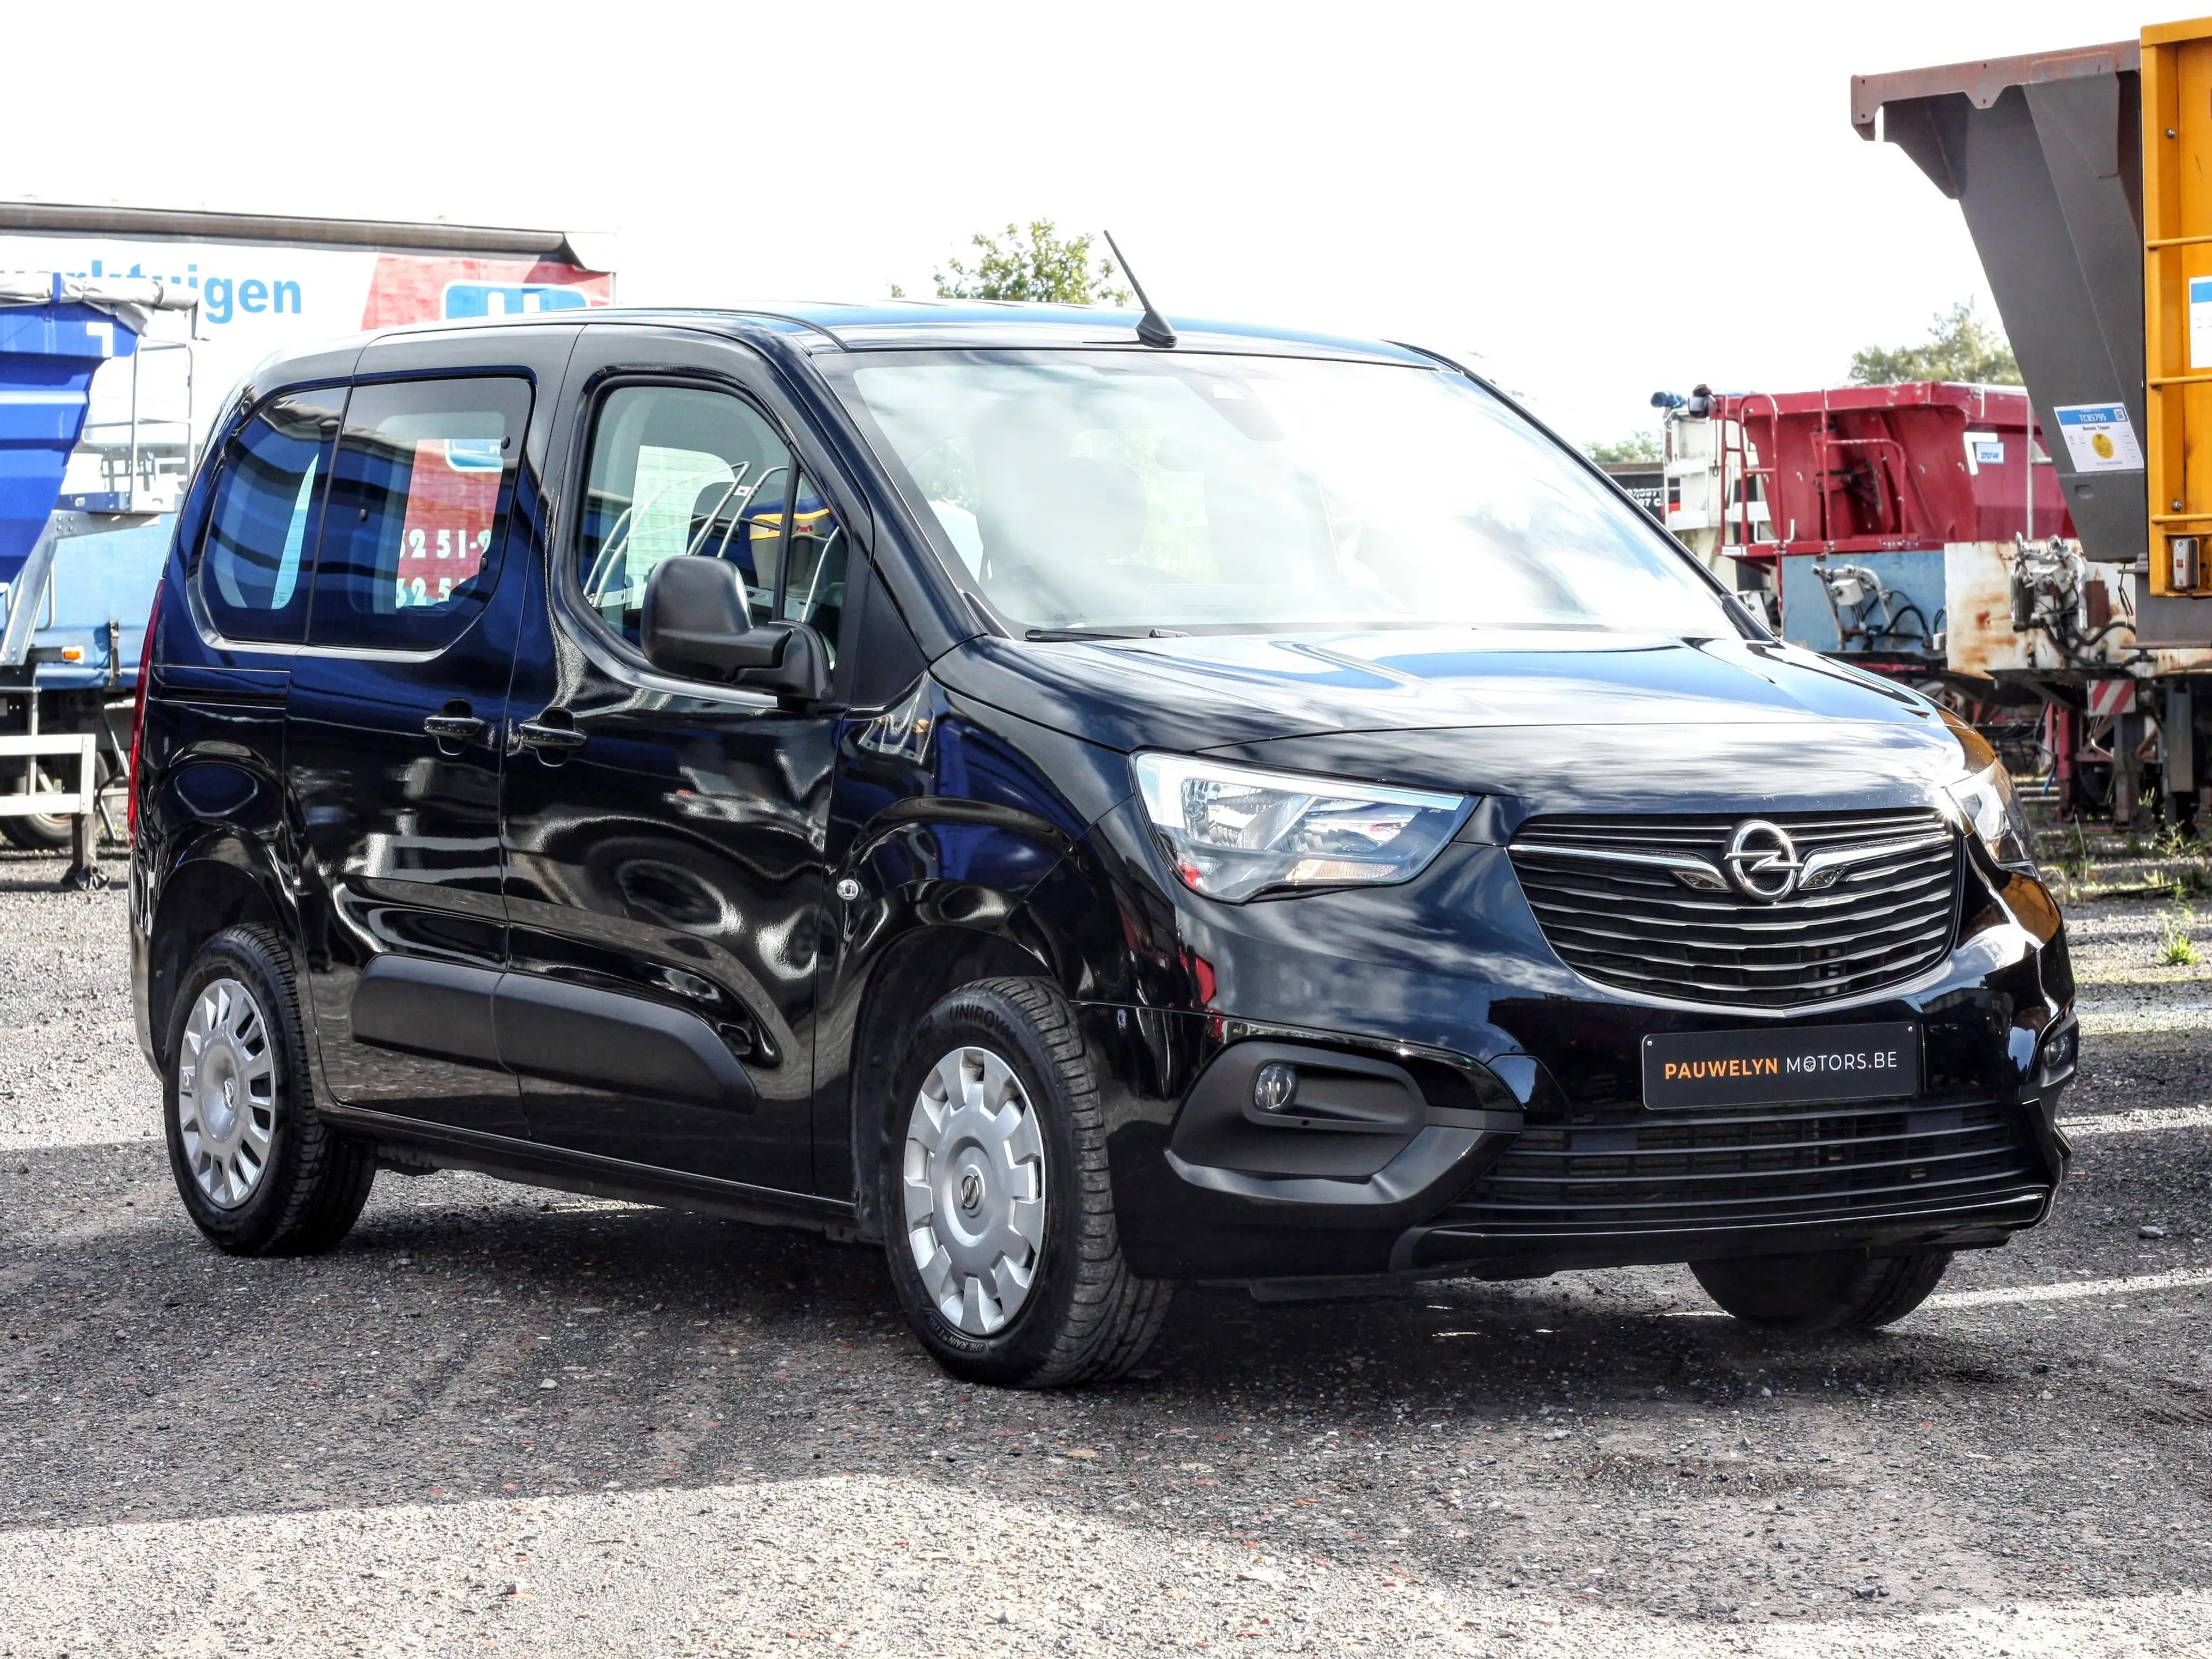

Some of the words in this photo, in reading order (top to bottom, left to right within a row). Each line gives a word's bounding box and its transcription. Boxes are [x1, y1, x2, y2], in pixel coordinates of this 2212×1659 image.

[1665, 1058, 1779, 1080] PAUWELYN
[1786, 1051, 1898, 1073] MOTORS.BE
[948, 1335, 967, 1350] RAIN
